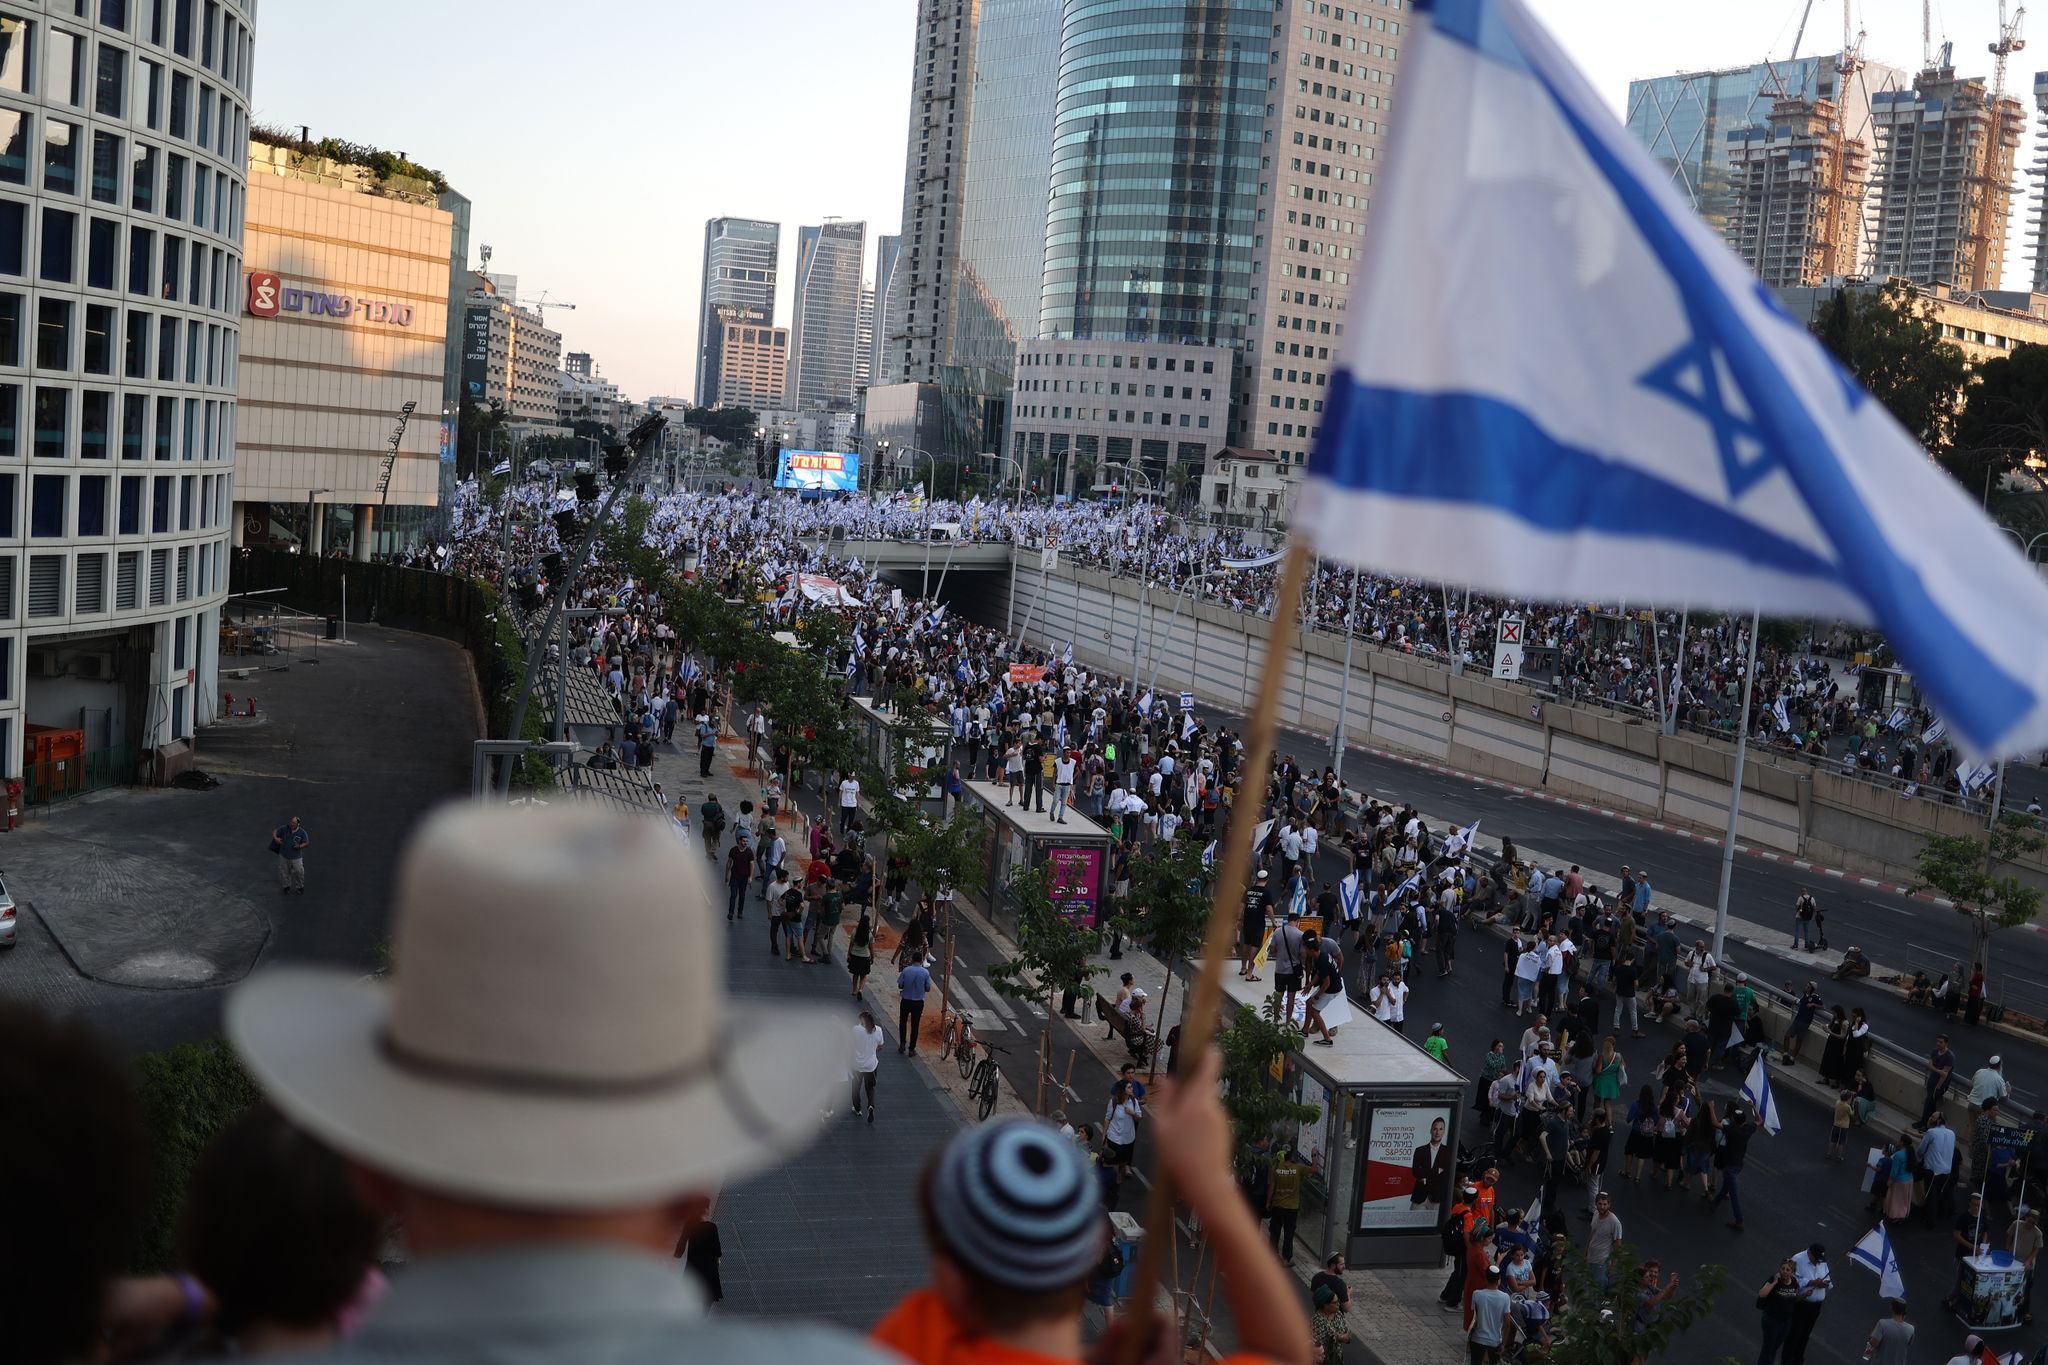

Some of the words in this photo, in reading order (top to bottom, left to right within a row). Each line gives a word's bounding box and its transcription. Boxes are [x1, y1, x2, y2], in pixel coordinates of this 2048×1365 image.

[283, 287, 414, 327] סופר-פארם
[746, 311, 764, 320] TOWER
[469, 322, 487, 330] להרוס
[1381, 1131, 1401, 1139] גדולה
[1402, 1132, 1415, 1140] הכי
[1370, 1139, 1392, 1148] מסלולי
[1393, 1140, 1413, 1148] בניהול
